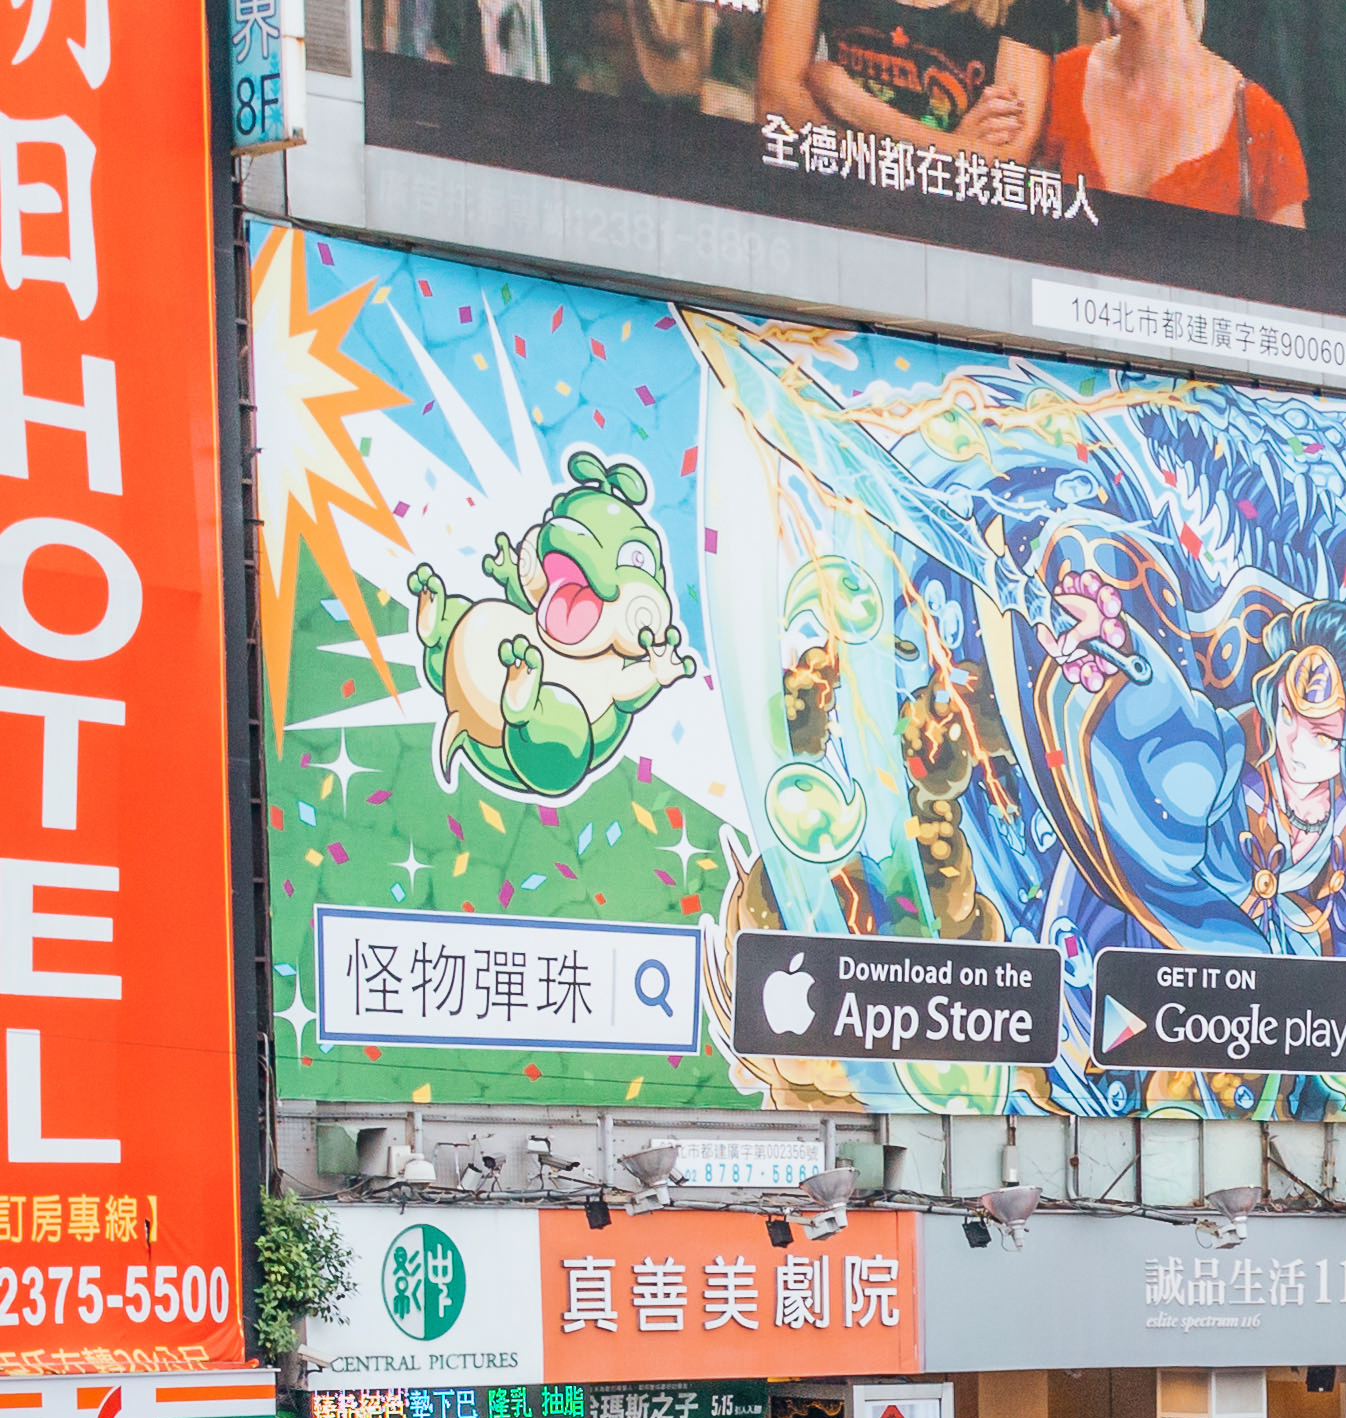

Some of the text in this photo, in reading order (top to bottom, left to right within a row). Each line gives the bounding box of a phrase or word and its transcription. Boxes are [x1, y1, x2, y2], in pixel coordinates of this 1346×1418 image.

[236, 73, 281, 138] 8F
[761, 114, 1100, 227] 全德州都在找這兩人
[0, 340, 143, 1164] HOTEL
[346, 937, 594, 1025] 怪物彈珠
[838, 954, 1033, 988] Download on the
[1156, 966, 1257, 991] GET IT ON
[834, 992, 1033, 1053] App Store
[1155, 1001, 1281, 1061] Google
[561, 1253, 901, 1334] 真善美劇院
[331, 1351, 520, 1374] CENTRAL PICTURES
[541, 1385, 585, 1418] 抽脂
[711, 1394, 734, 1417] 5/15
